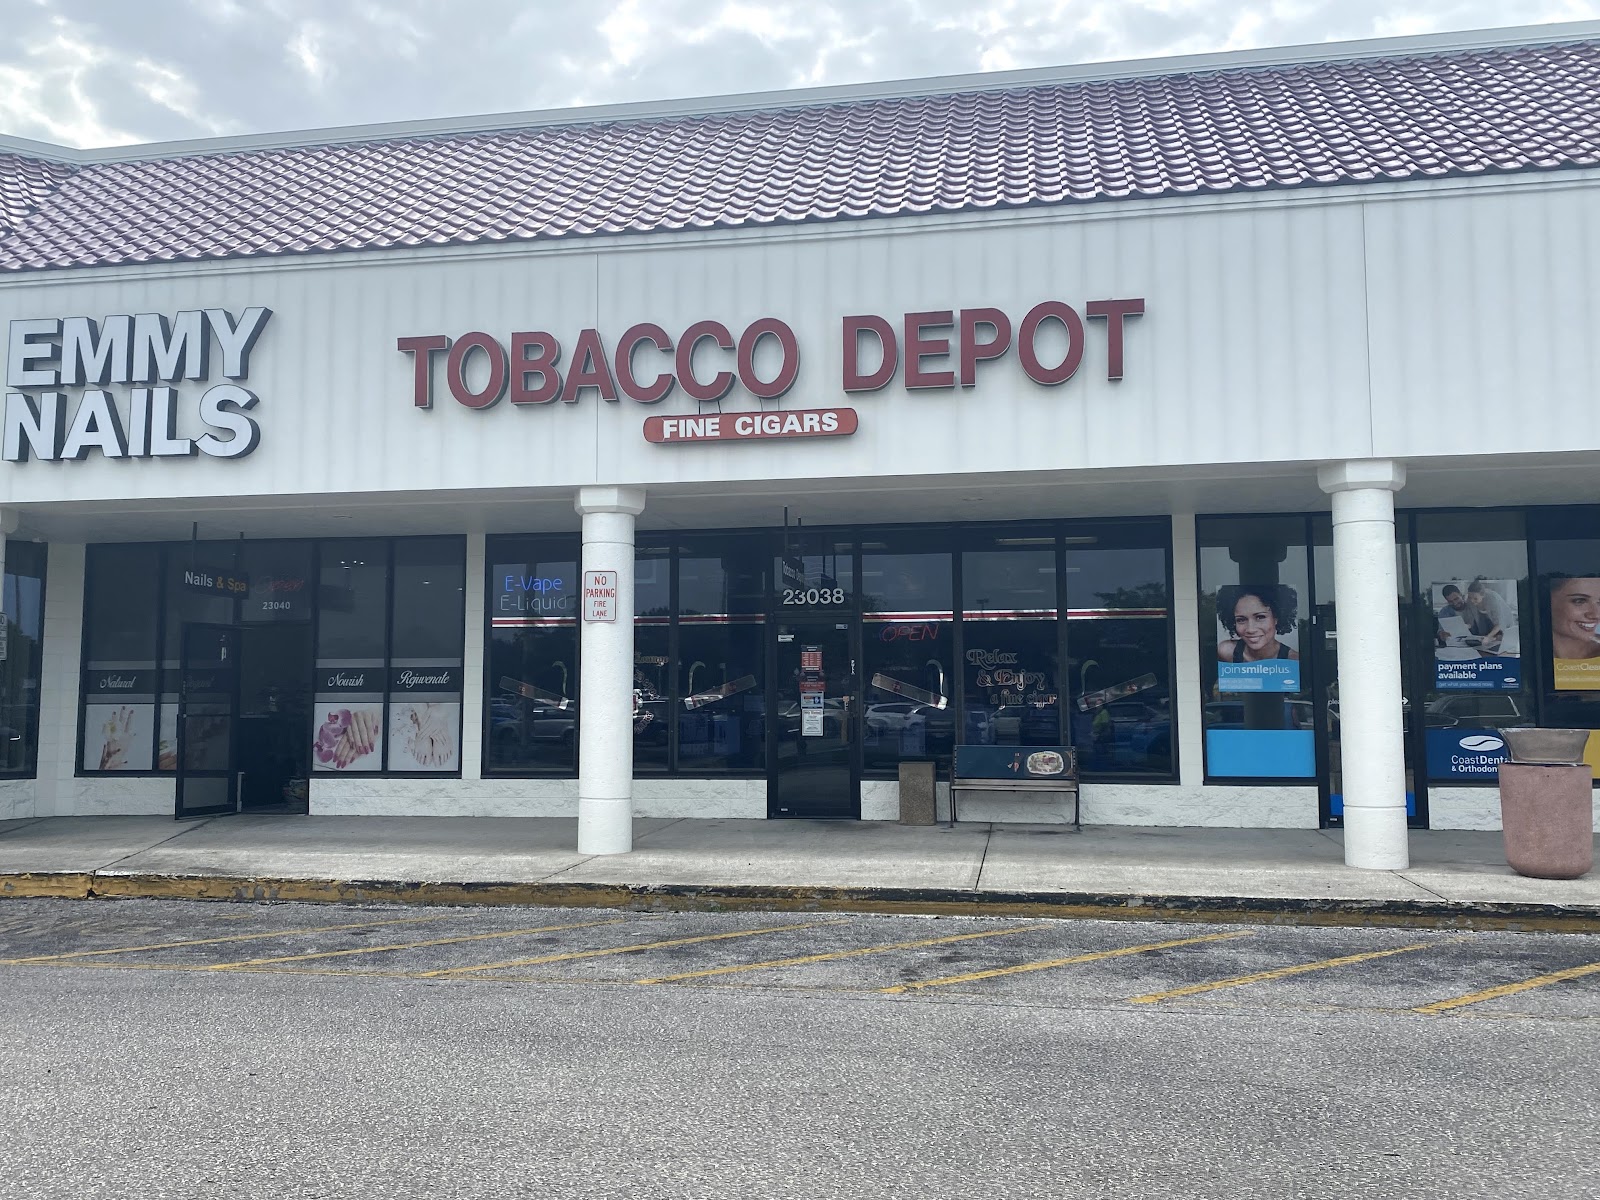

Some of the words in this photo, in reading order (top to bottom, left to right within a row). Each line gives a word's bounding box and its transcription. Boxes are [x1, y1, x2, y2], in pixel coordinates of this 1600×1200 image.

[6, 306, 273, 388] EMMY
[397, 317, 800, 411] TOBACCO
[842, 298, 1145, 394] DEPOT
[2, 384, 260, 462] NAILS
[663, 417, 721, 440] FINE
[734, 412, 839, 435] CIGARS
[184, 570, 213, 588] Nails
[215, 576, 225, 590] &
[227, 577, 247, 594] Spa
[505, 575, 563, 595] E-Vape
[594, 576, 607, 586] NO
[586, 588, 616, 598] PARKING
[782, 587, 846, 605] 23038
[262, 601, 291, 610] 23040
[500, 594, 567, 614] E-Liquid
[592, 609, 608, 617] LANE
[593, 600, 607, 608] FIRE
[881, 623, 939, 642] OPEN
[965, 648, 1018, 671] Relax
[1438, 663, 1477, 672] payment
[1479, 661, 1503, 672] plans
[99, 674, 137, 689] Natural
[327, 672, 365, 687] Nourish
[396, 669, 450, 689] Rejuvenate
[976, 670, 992, 687] &
[993, 668, 1046, 691] Enjoy
[1438, 671, 1477, 680] available
[989, 692, 1000, 705] a
[1000, 689, 1025, 710] fine
[1026, 691, 1057, 710] cigar
[1458, 764, 1499, 773] Orthodon
